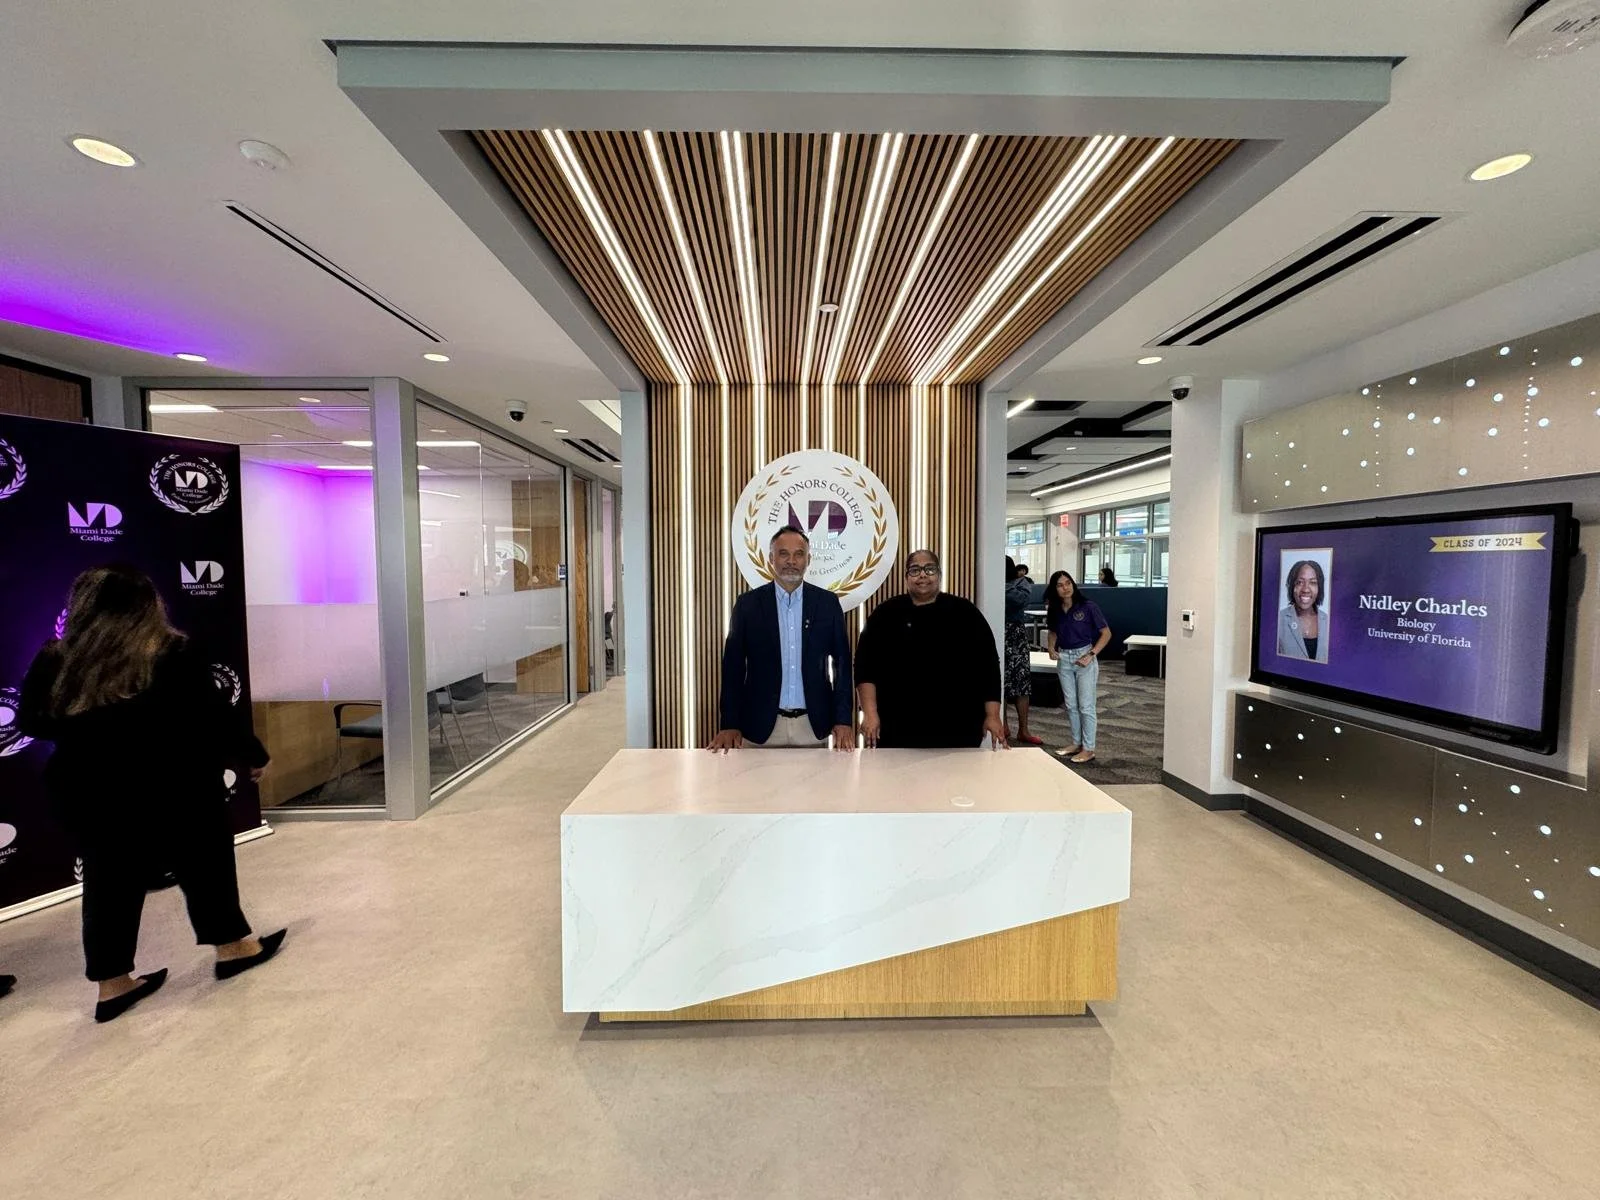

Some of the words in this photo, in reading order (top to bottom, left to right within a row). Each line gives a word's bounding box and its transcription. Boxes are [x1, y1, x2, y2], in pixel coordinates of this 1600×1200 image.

[768, 500, 783, 525] THE
[780, 479, 827, 501] HONORS
[829, 483, 864, 526] COLLEGE
[80, 535, 115, 543] College
[1443, 539, 1474, 548] CLASS
[1478, 539, 1491, 547] OF
[1495, 537, 1522, 546] 2024
[1358, 594, 1412, 615] Nidley
[1415, 598, 1488, 617] Charles
[1397, 617, 1437, 632] Biology
[1367, 628, 1416, 644] University
[1417, 633, 1429, 643] of
[1431, 634, 1472, 649] Florida
